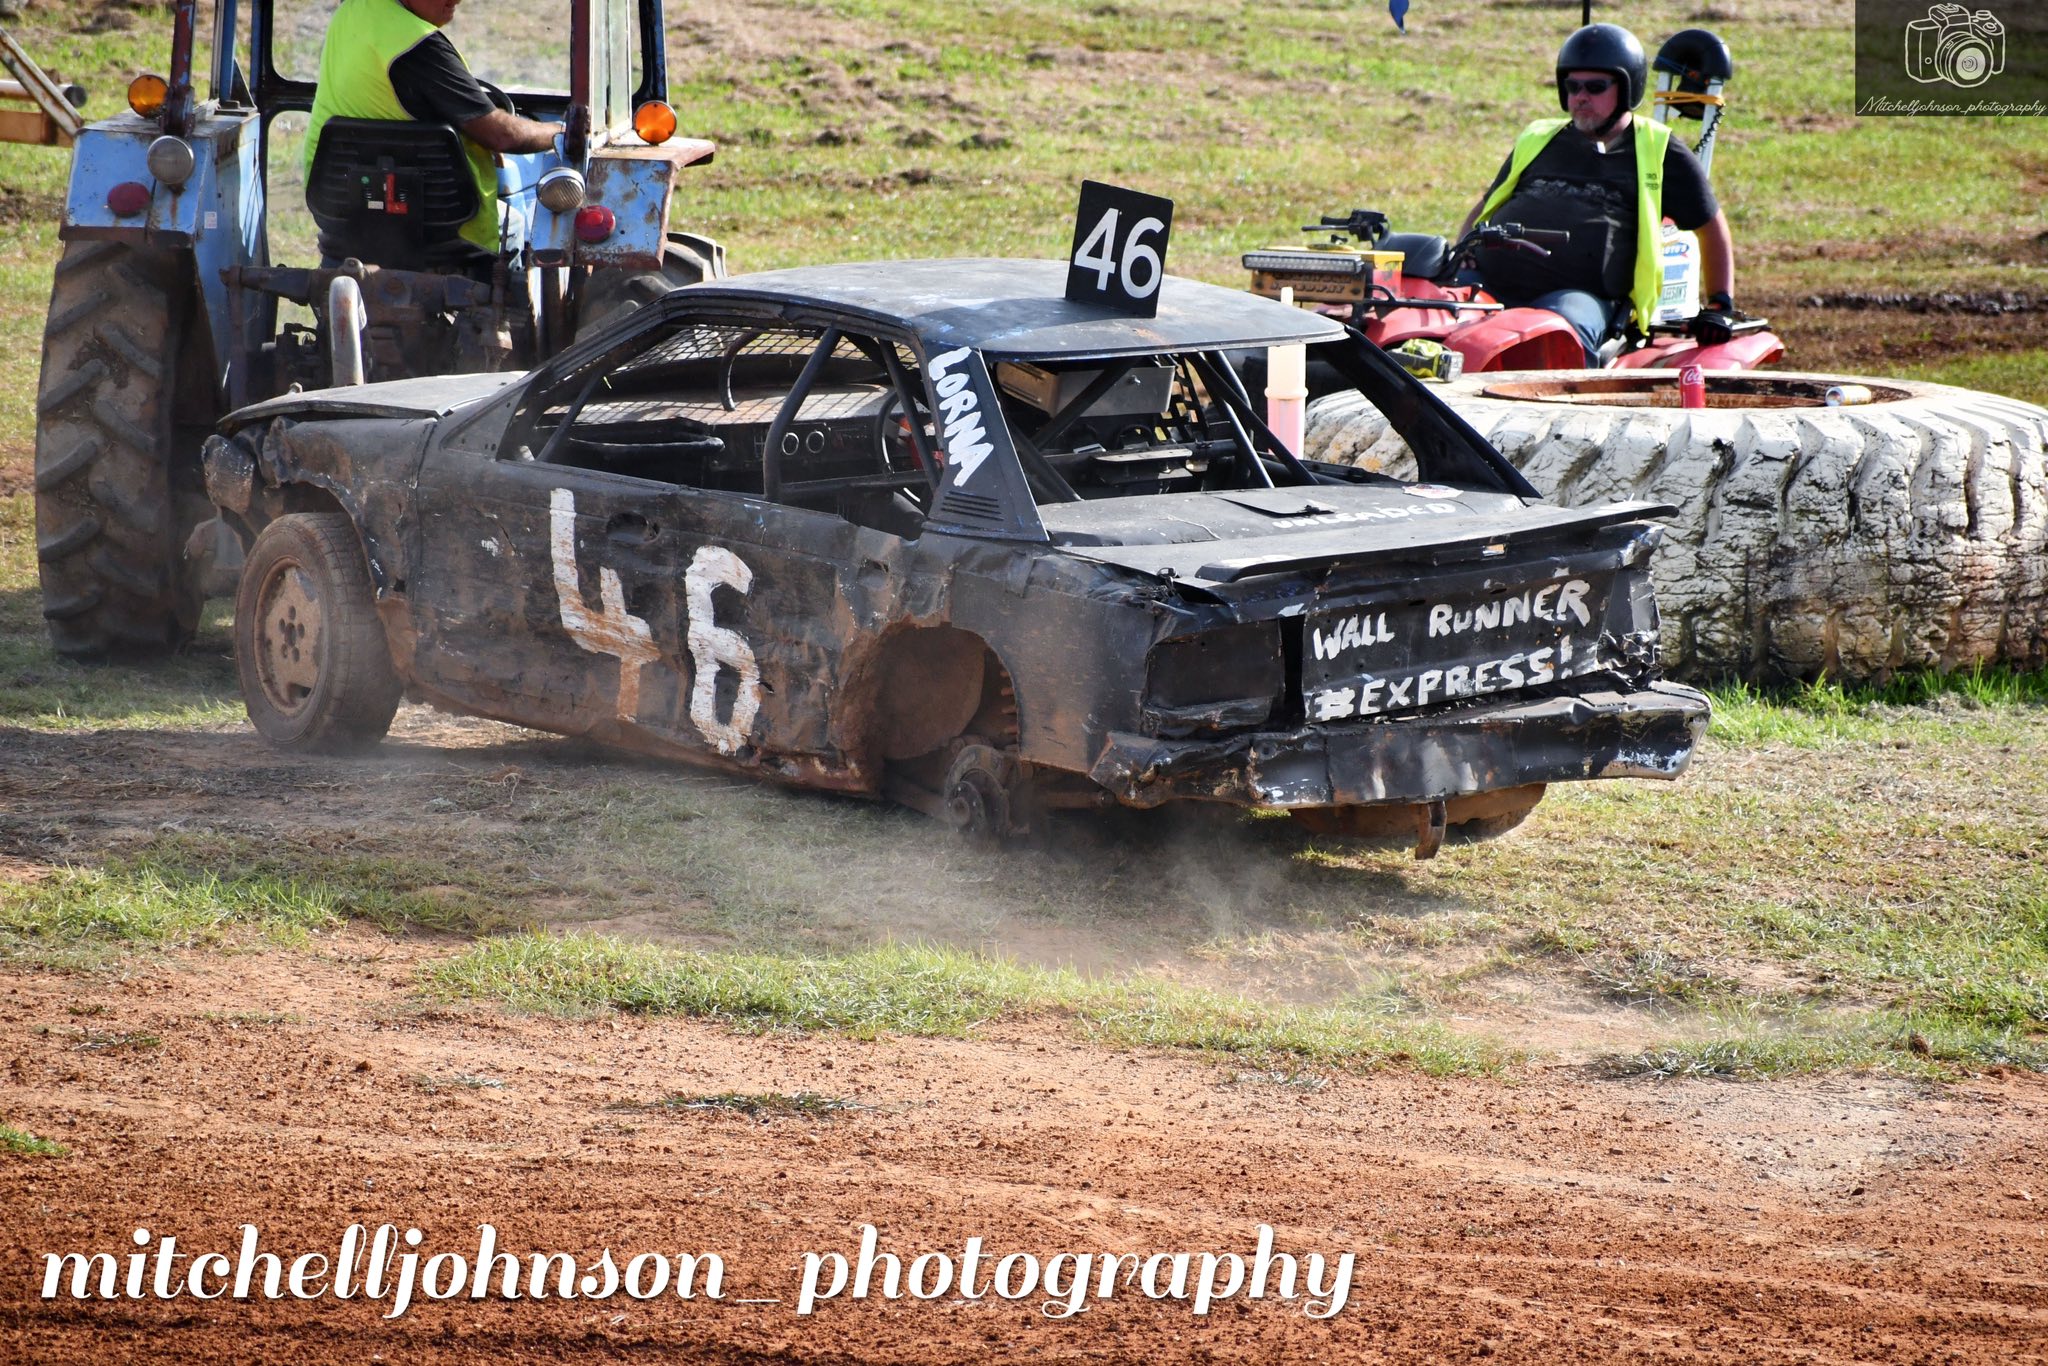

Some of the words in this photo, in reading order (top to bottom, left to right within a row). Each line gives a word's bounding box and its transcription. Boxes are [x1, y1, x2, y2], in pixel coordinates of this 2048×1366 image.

[1074, 207, 1165, 299] 46
[928, 346, 994, 487] LORNA
[1272, 502, 1457, 529] UNLEADED
[550, 487, 762, 756] 46
[1313, 612, 1395, 661] WALL
[1429, 579, 1591, 638] RUNNER
